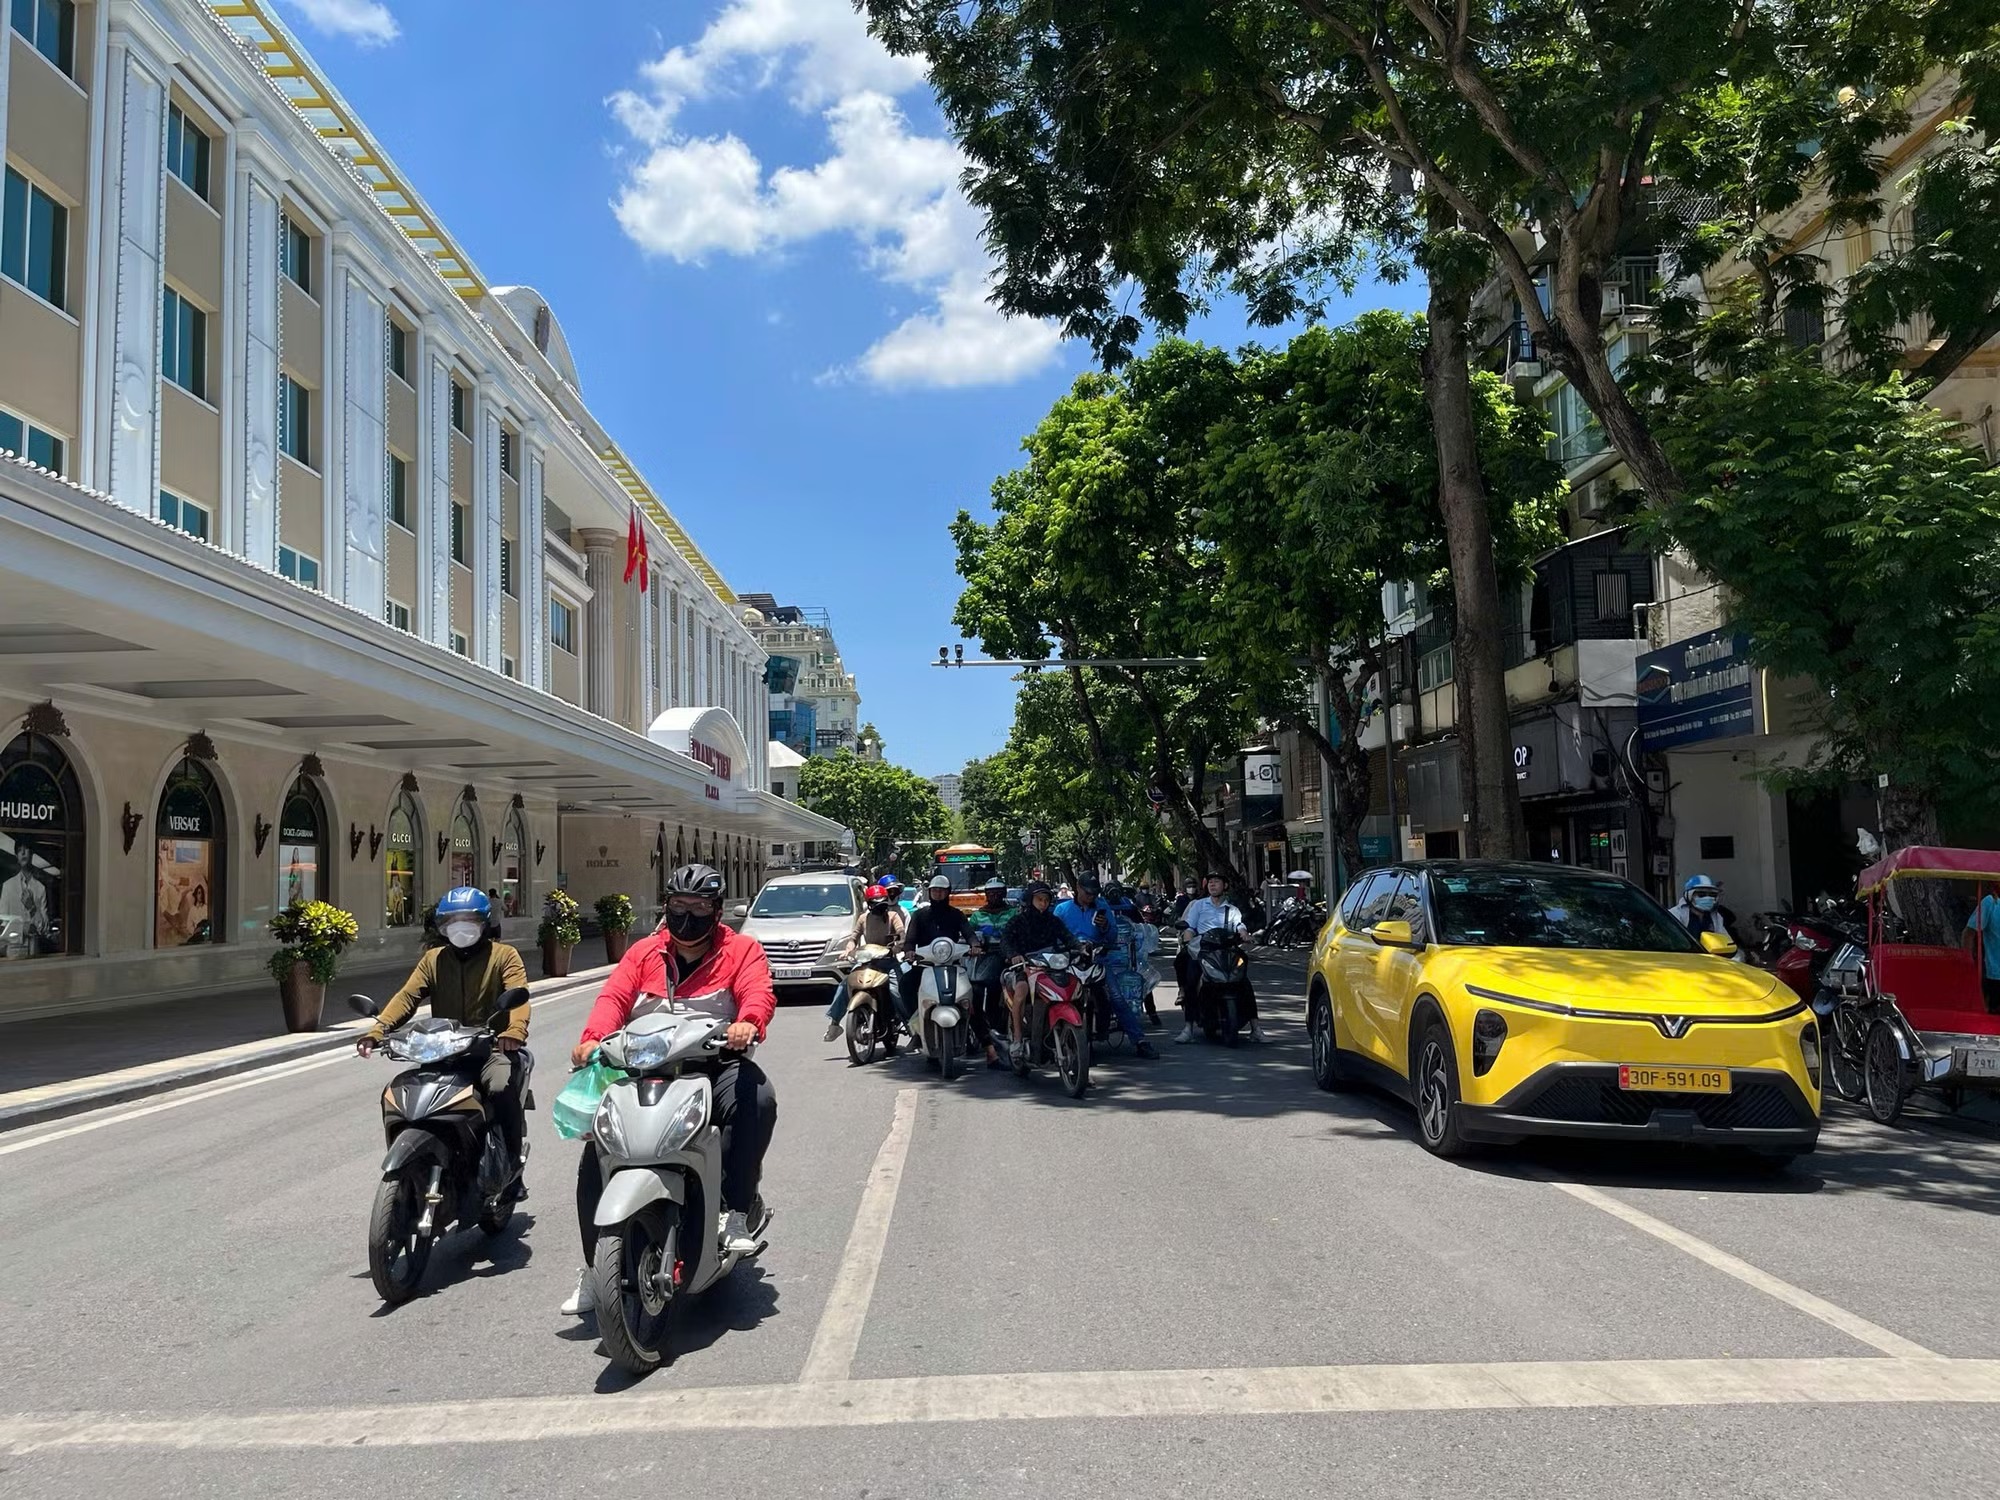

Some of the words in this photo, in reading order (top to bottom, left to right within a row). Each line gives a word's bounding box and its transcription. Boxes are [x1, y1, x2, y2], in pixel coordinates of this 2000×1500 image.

[705, 783, 720, 800] PLAZA
[1, 801, 55, 820] HUBLOT
[169, 815, 200, 831] VERSACE
[392, 833, 411, 843] GUCCI
[455, 838, 471, 847] GUCCI
[505, 842, 519, 850] GUCCI
[586, 860, 619, 868] ROLEX
[1630, 1070, 1721, 1088] 30F-591.09
